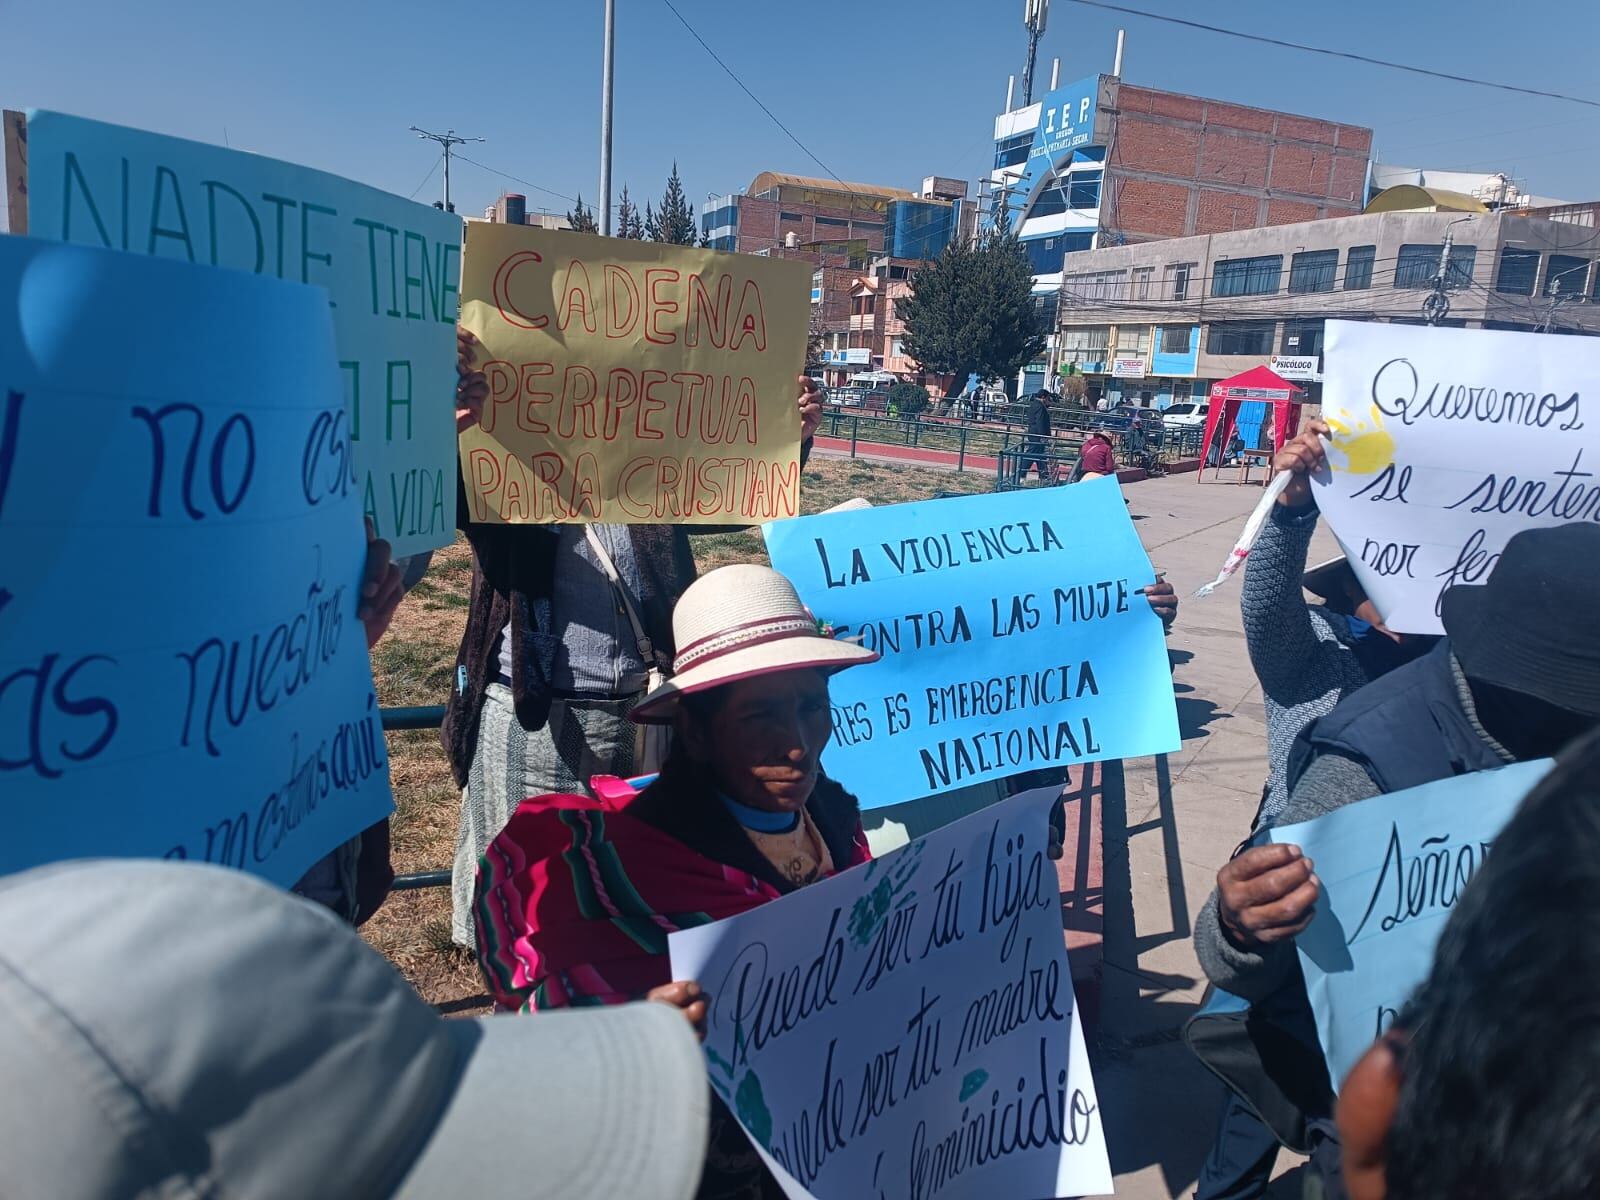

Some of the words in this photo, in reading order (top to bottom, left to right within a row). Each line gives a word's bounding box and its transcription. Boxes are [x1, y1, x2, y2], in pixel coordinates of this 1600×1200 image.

[353, 217, 460, 325] TIENE
[492, 250, 767, 352] CADENA
[479, 360, 758, 446] PERPETUA
[1276, 359, 1312, 369] PSICÓLOGO
[1371, 357, 1585, 432] Queremos
[130, 402, 256, 521] no
[469, 448, 602, 521] PARA
[616, 455, 799, 520] CRISTIAN
[1349, 462, 1413, 504] se
[390, 468, 446, 538] VIDA
[881, 520, 1065, 575] VIOLENCIA
[832, 605, 972, 657] ONTRA
[990, 593, 1041, 638] LAS
[829, 702, 874, 748] RES
[885, 692, 913, 736] ES
[927, 660, 1100, 726] EMERGENCIA
[918, 717, 1101, 791] NACIONAL
[712, 907, 845, 1074] Puede
[852, 900, 920, 996] ser
[919, 848, 965, 960] tu
[850, 1044, 901, 1140] ser
[903, 986, 943, 1099] tu
[909, 1036, 1097, 1200] feminicidio
